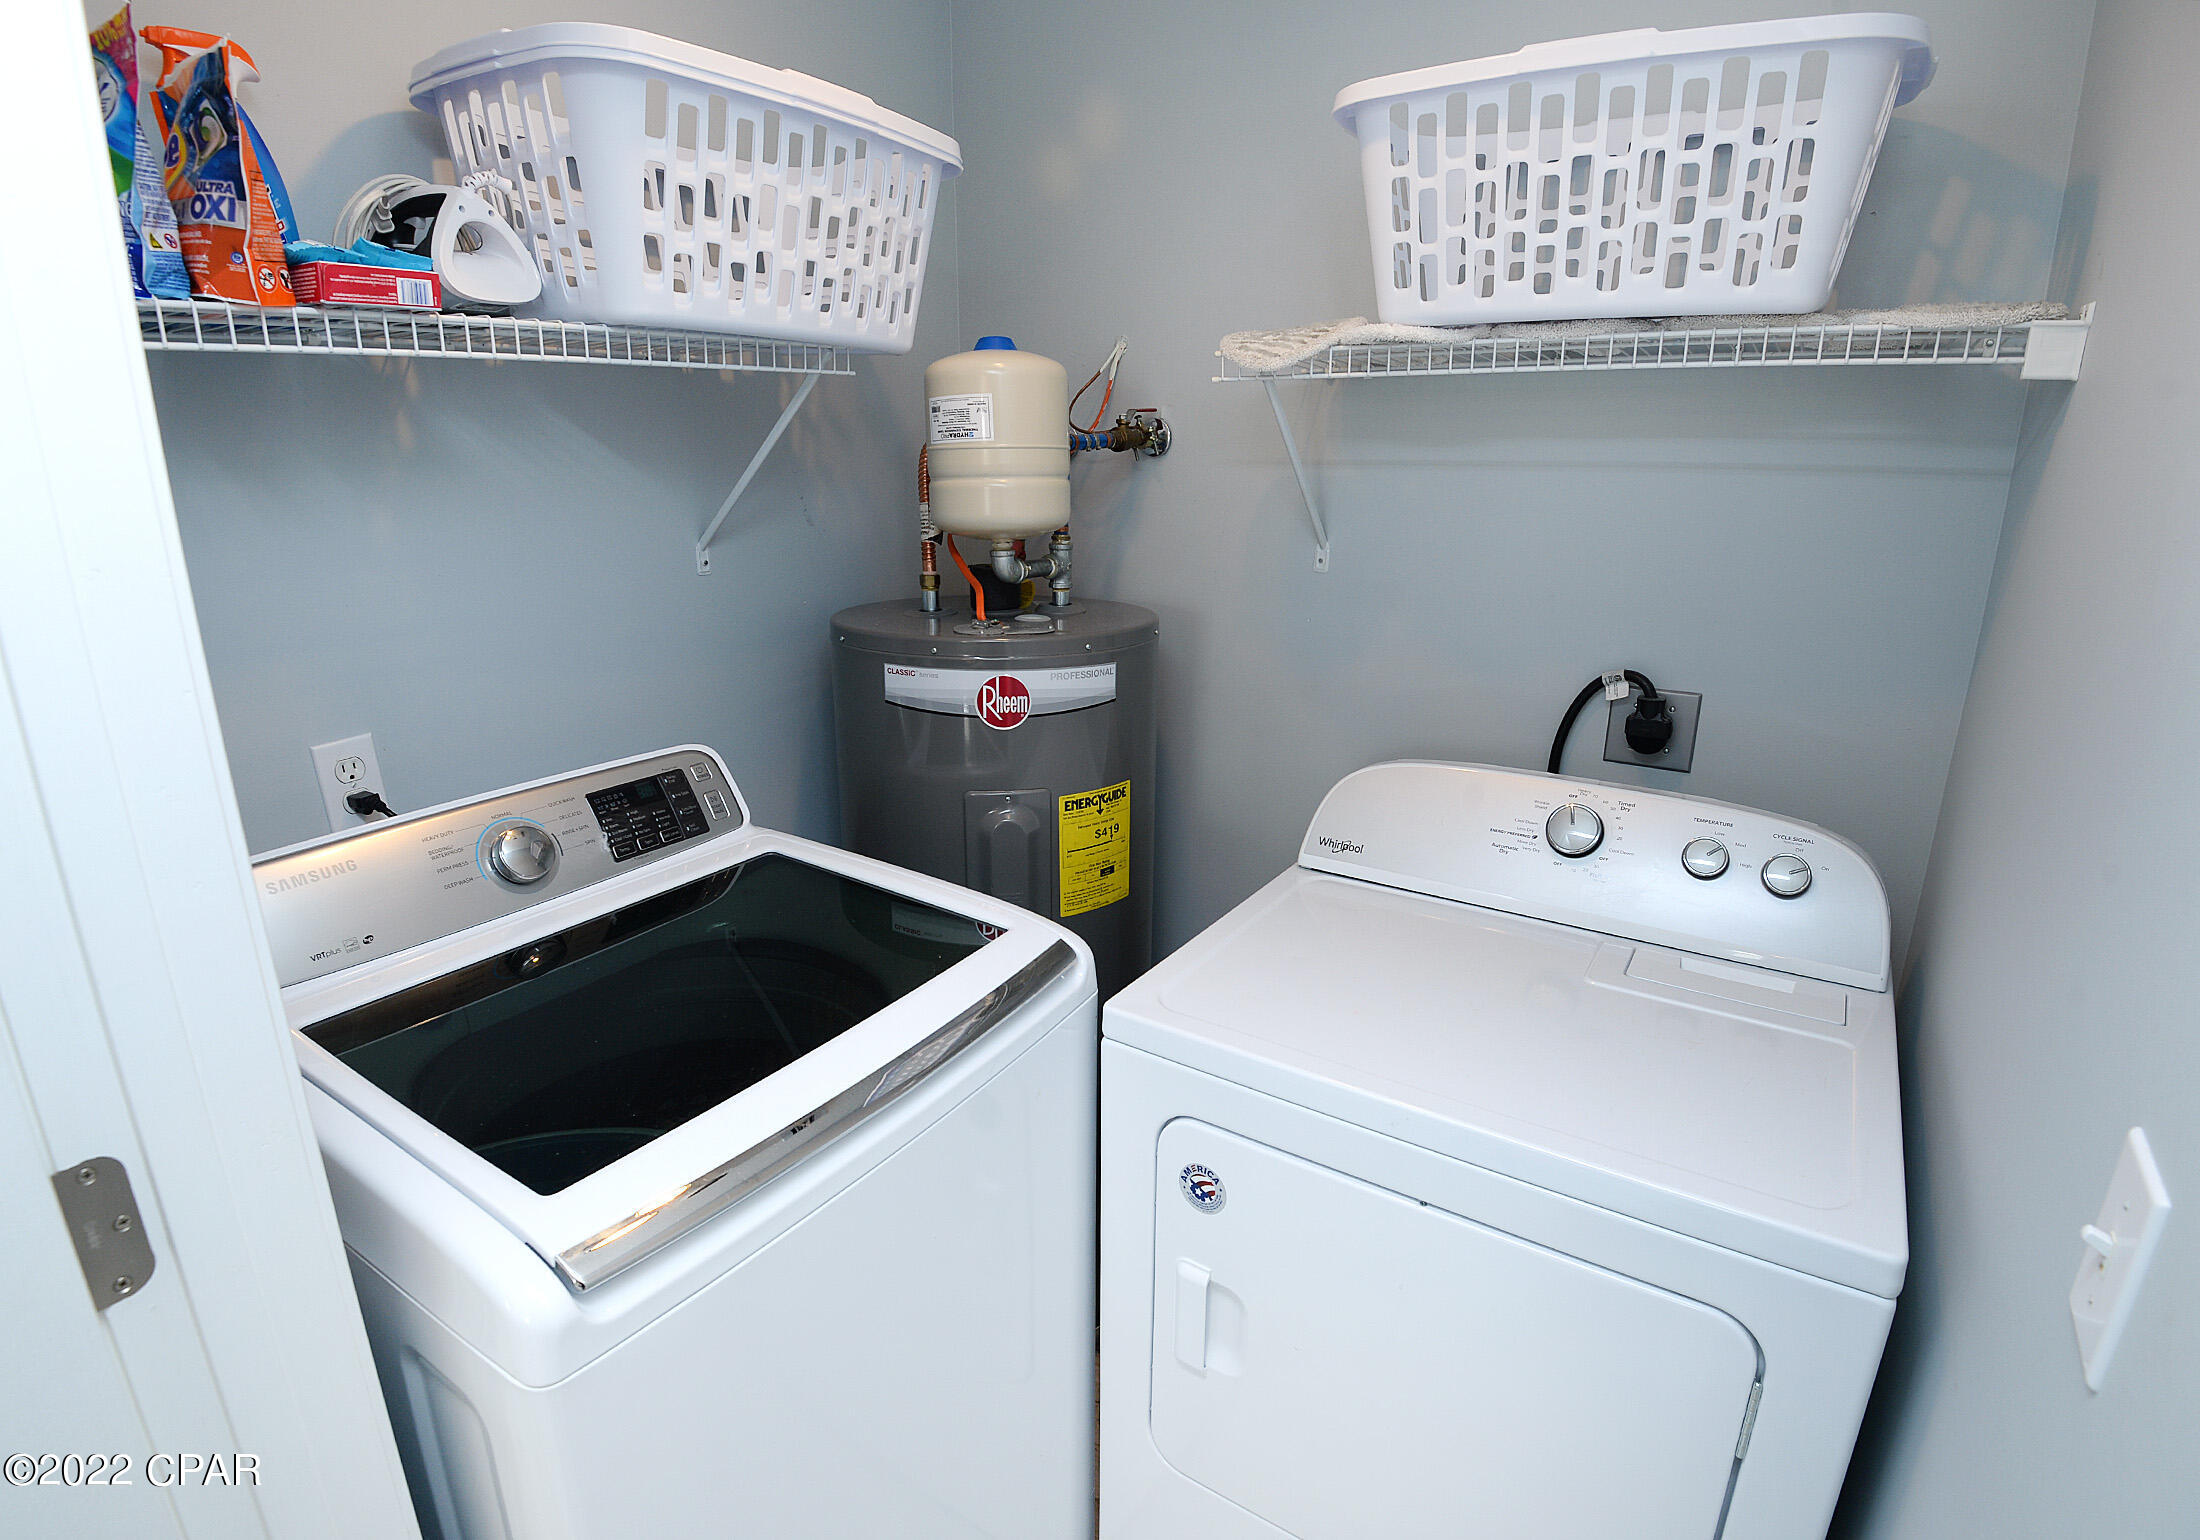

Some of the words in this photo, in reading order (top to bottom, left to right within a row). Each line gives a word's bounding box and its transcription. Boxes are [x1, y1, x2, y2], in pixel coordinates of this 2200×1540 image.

[196, 181, 234, 195] ULTRA
[190, 193, 236, 222] OXI
[887, 667, 916, 677] CLASSIC
[1050, 668, 1114, 681] PROFESSIONAL
[982, 677, 1028, 721] Rheem
[1064, 786, 1127, 812] ENERGYGUIDE
[1618, 800, 1636, 808] Timed
[1693, 817, 1734, 828] TEMPERATURE
[1319, 836, 1364, 853] Whirlpool
[1772, 832, 1792, 842] CYCLE
[1792, 835, 1815, 845] SIGNAL
[1491, 841, 1519, 852] Automatic
[1499, 847, 1509, 855] Dry
[265, 859, 358, 895] SAMSUNG
[1180, 1164, 1220, 1186] AMERICA
